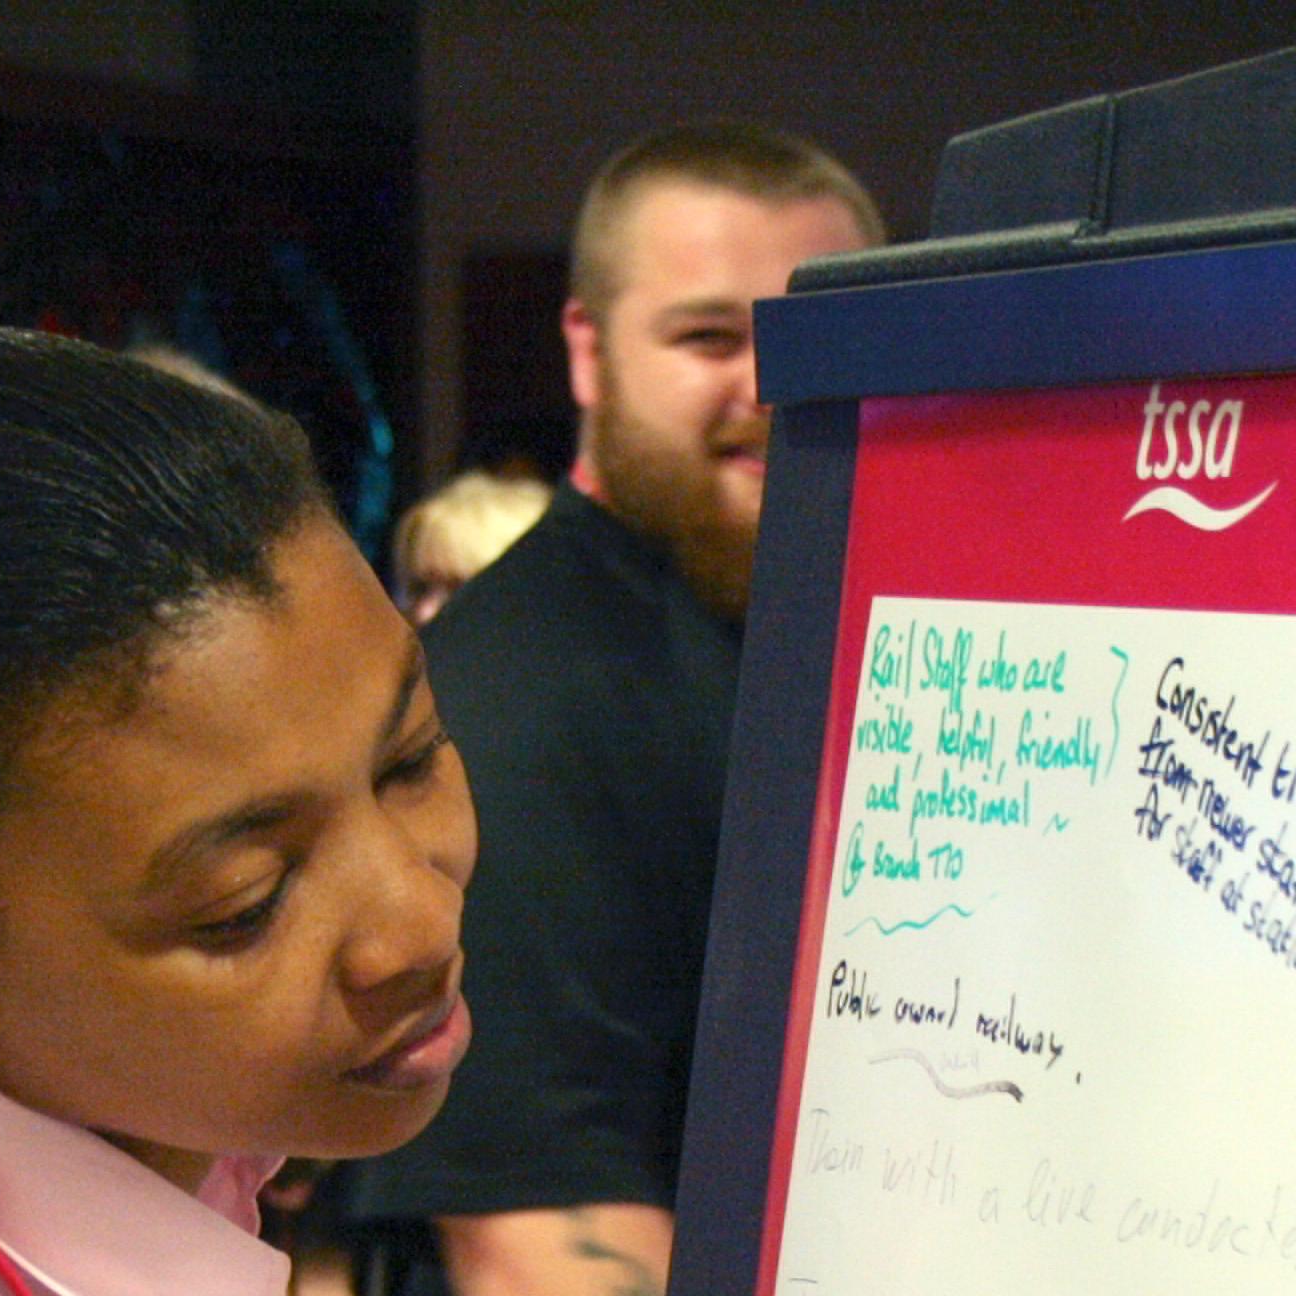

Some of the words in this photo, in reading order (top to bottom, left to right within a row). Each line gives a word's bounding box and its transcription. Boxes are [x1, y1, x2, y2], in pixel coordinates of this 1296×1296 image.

[1135, 382, 1244, 480] tssa
[869, 620, 915, 698] Rail
[978, 630, 1019, 692] who
[1023, 650, 1067, 694] are
[1016, 710, 1101, 786] friendly
[1154, 657, 1272, 788] Consistent
[865, 765, 900, 813] and
